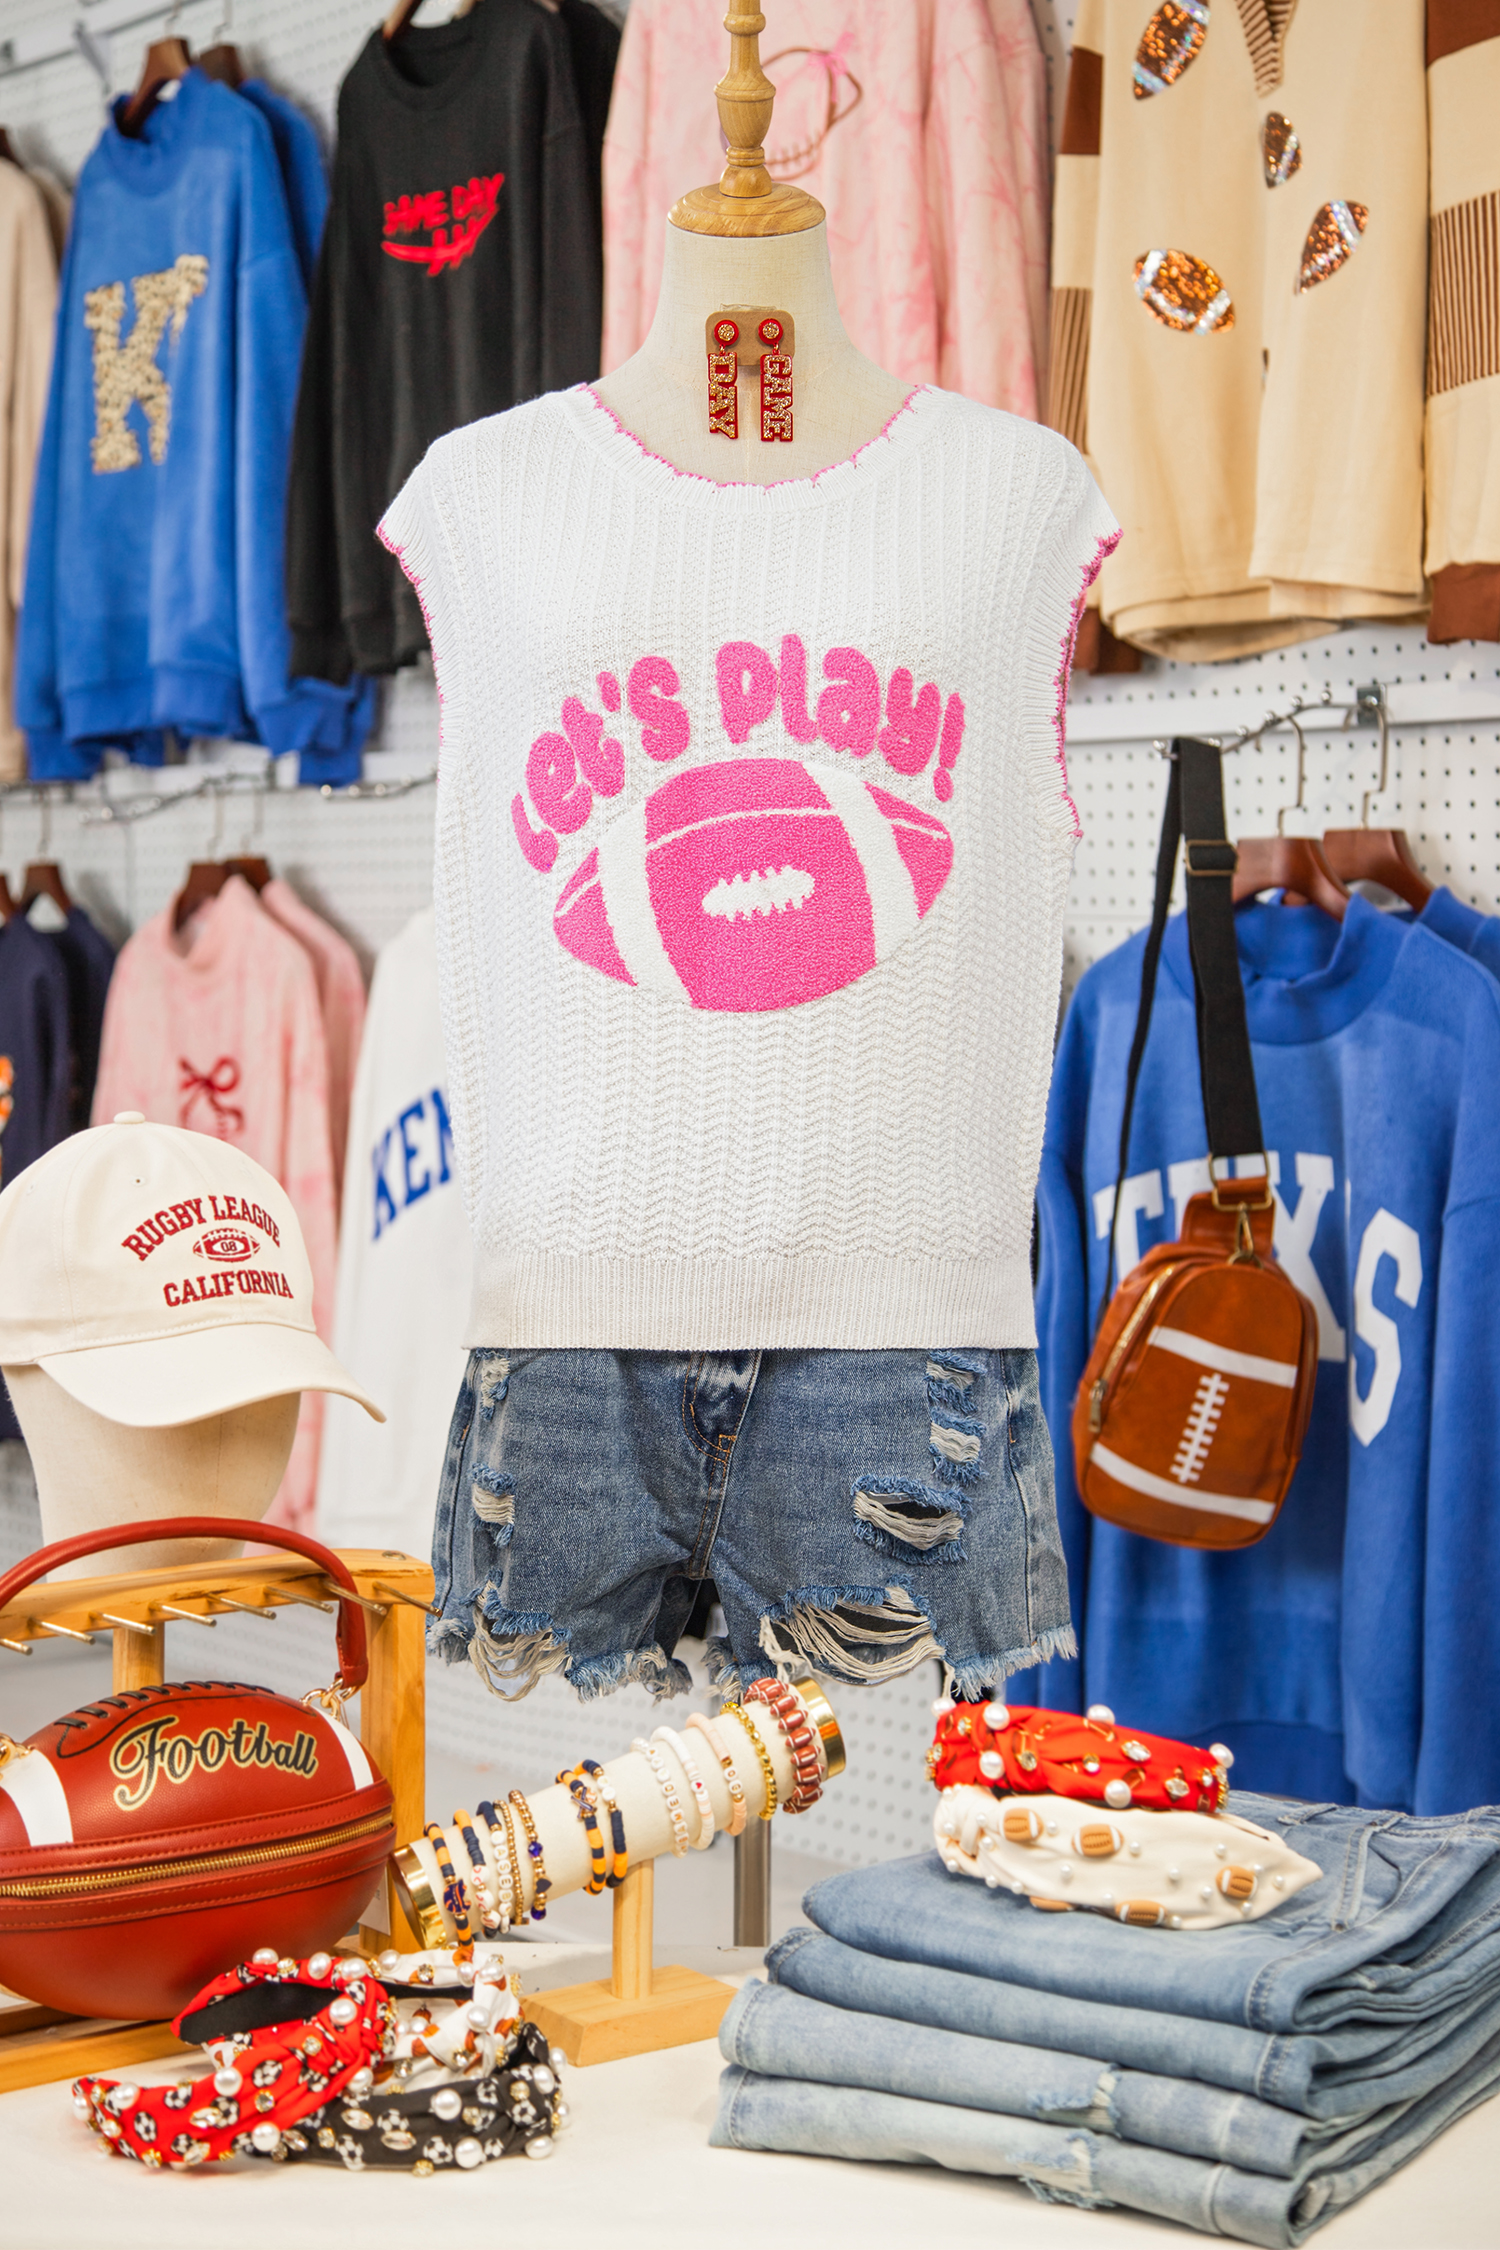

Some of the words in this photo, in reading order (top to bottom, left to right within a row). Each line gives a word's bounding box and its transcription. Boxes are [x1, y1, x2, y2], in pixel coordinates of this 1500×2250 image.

[707, 351, 738, 439] DAY
[760, 353, 793, 442] GAME
[121, 1197, 207, 1261] RUGBY
[207, 1195, 280, 1248] LEAGUE
[163, 1269, 294, 1307] CALIFORNIA
[110, 1714, 319, 1811] Football
